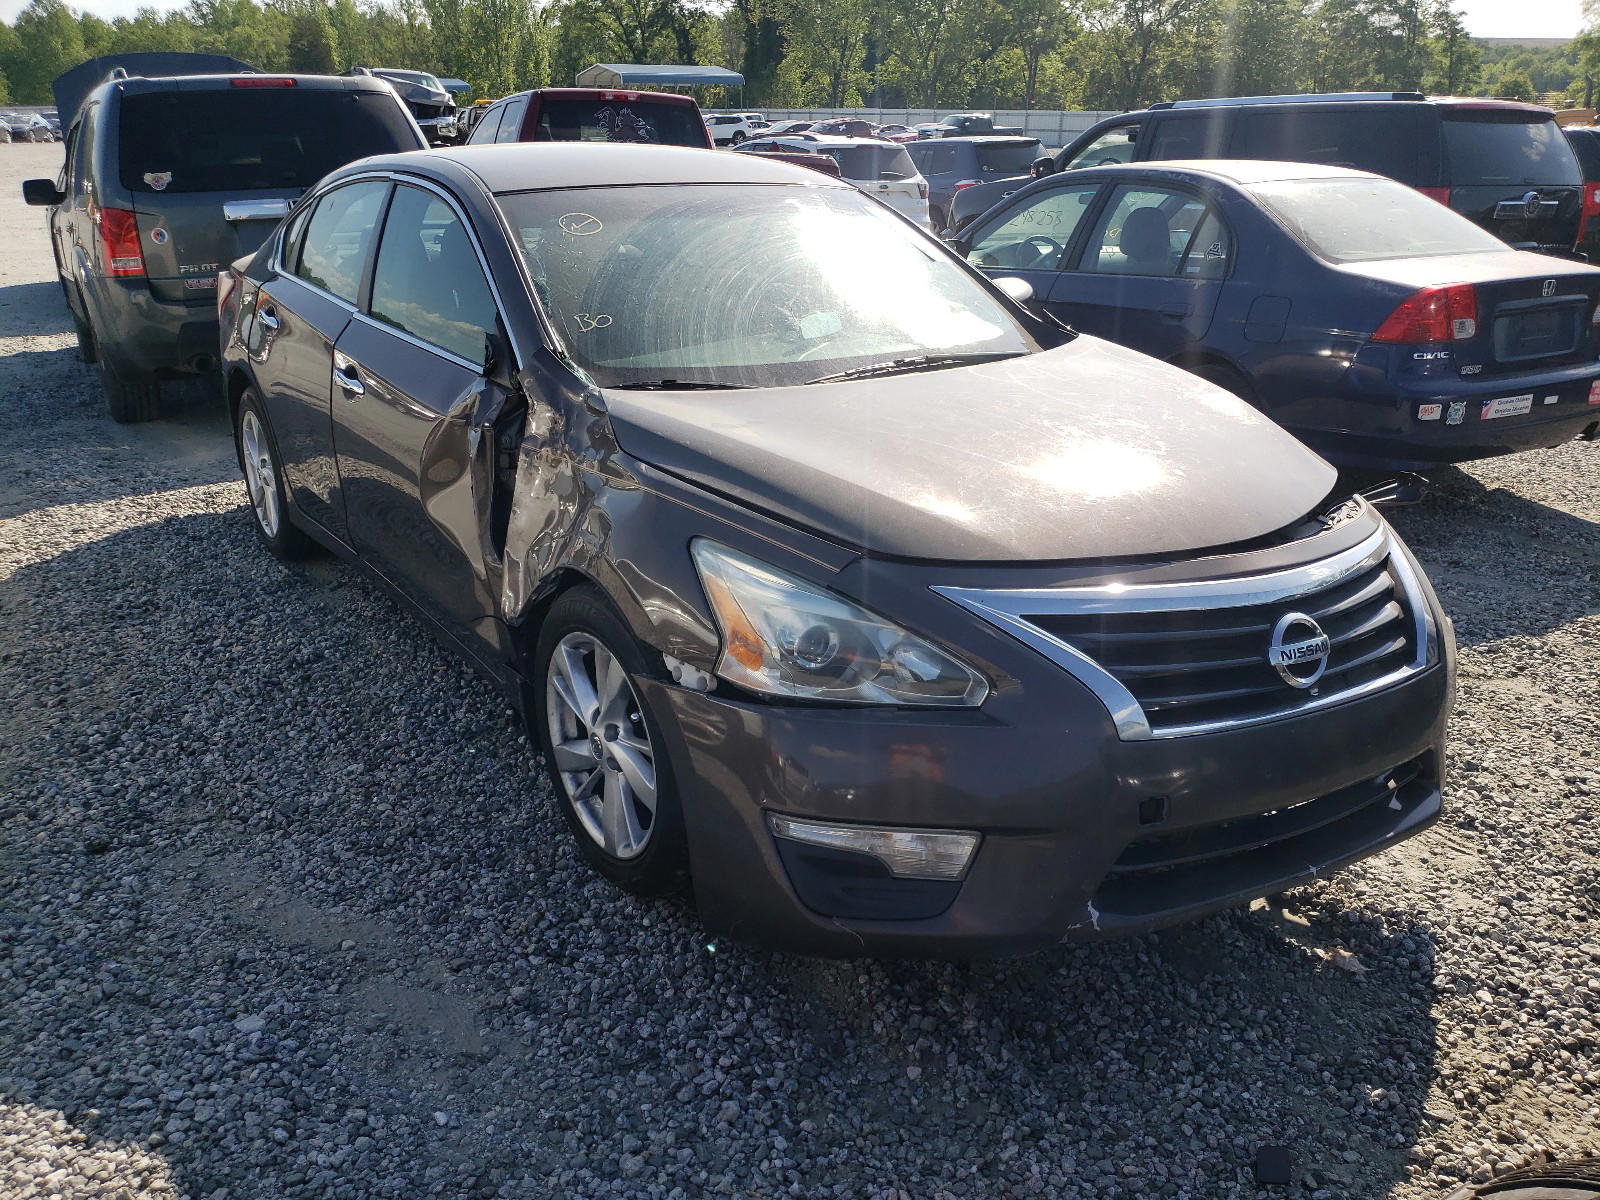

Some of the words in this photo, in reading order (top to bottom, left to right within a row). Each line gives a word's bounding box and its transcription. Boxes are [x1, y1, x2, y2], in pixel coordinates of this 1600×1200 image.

[178, 263, 219, 273] PILOT
[1413, 351, 1449, 360] CIVIC
[1280, 641, 1328, 661] NISSAN
